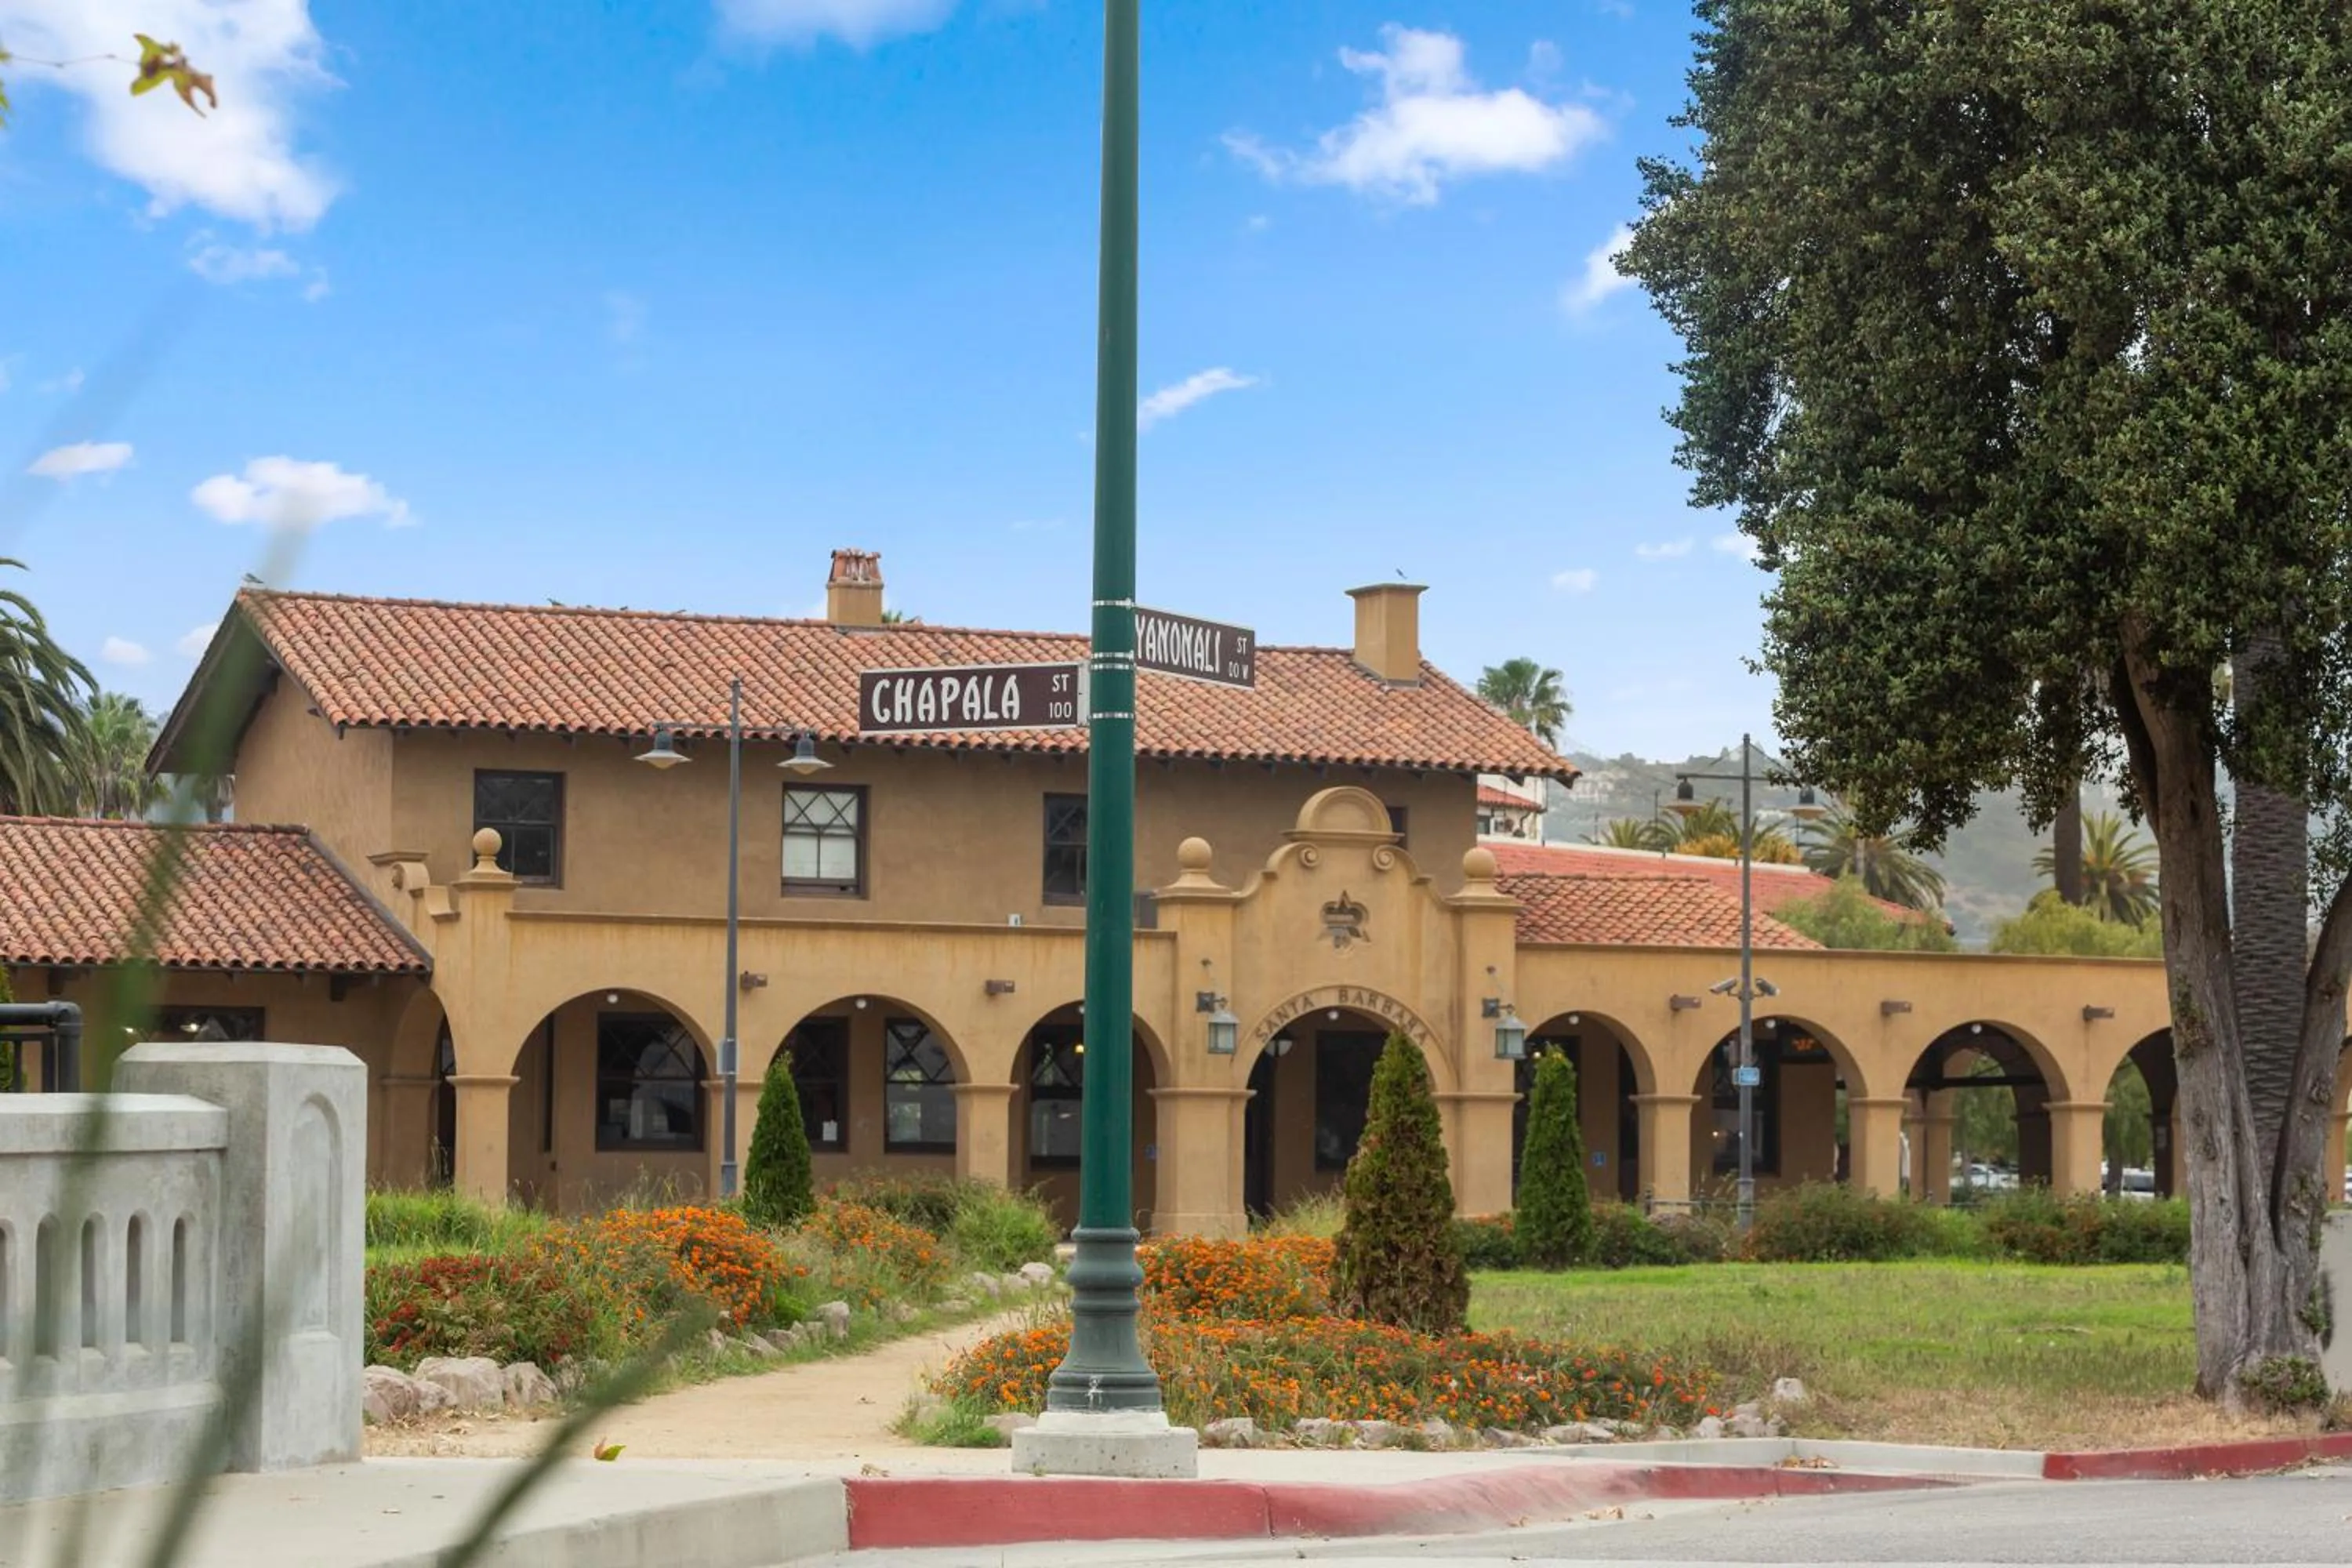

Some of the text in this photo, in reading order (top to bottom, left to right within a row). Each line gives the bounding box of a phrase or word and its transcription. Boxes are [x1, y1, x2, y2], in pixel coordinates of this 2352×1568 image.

[1134, 614, 1247, 673] YANONALI ST
[872, 673, 1070, 723] CHAPALA ST
[1048, 702, 1073, 719] 100
[1256, 989, 1428, 1046] SANTA BARBARA
